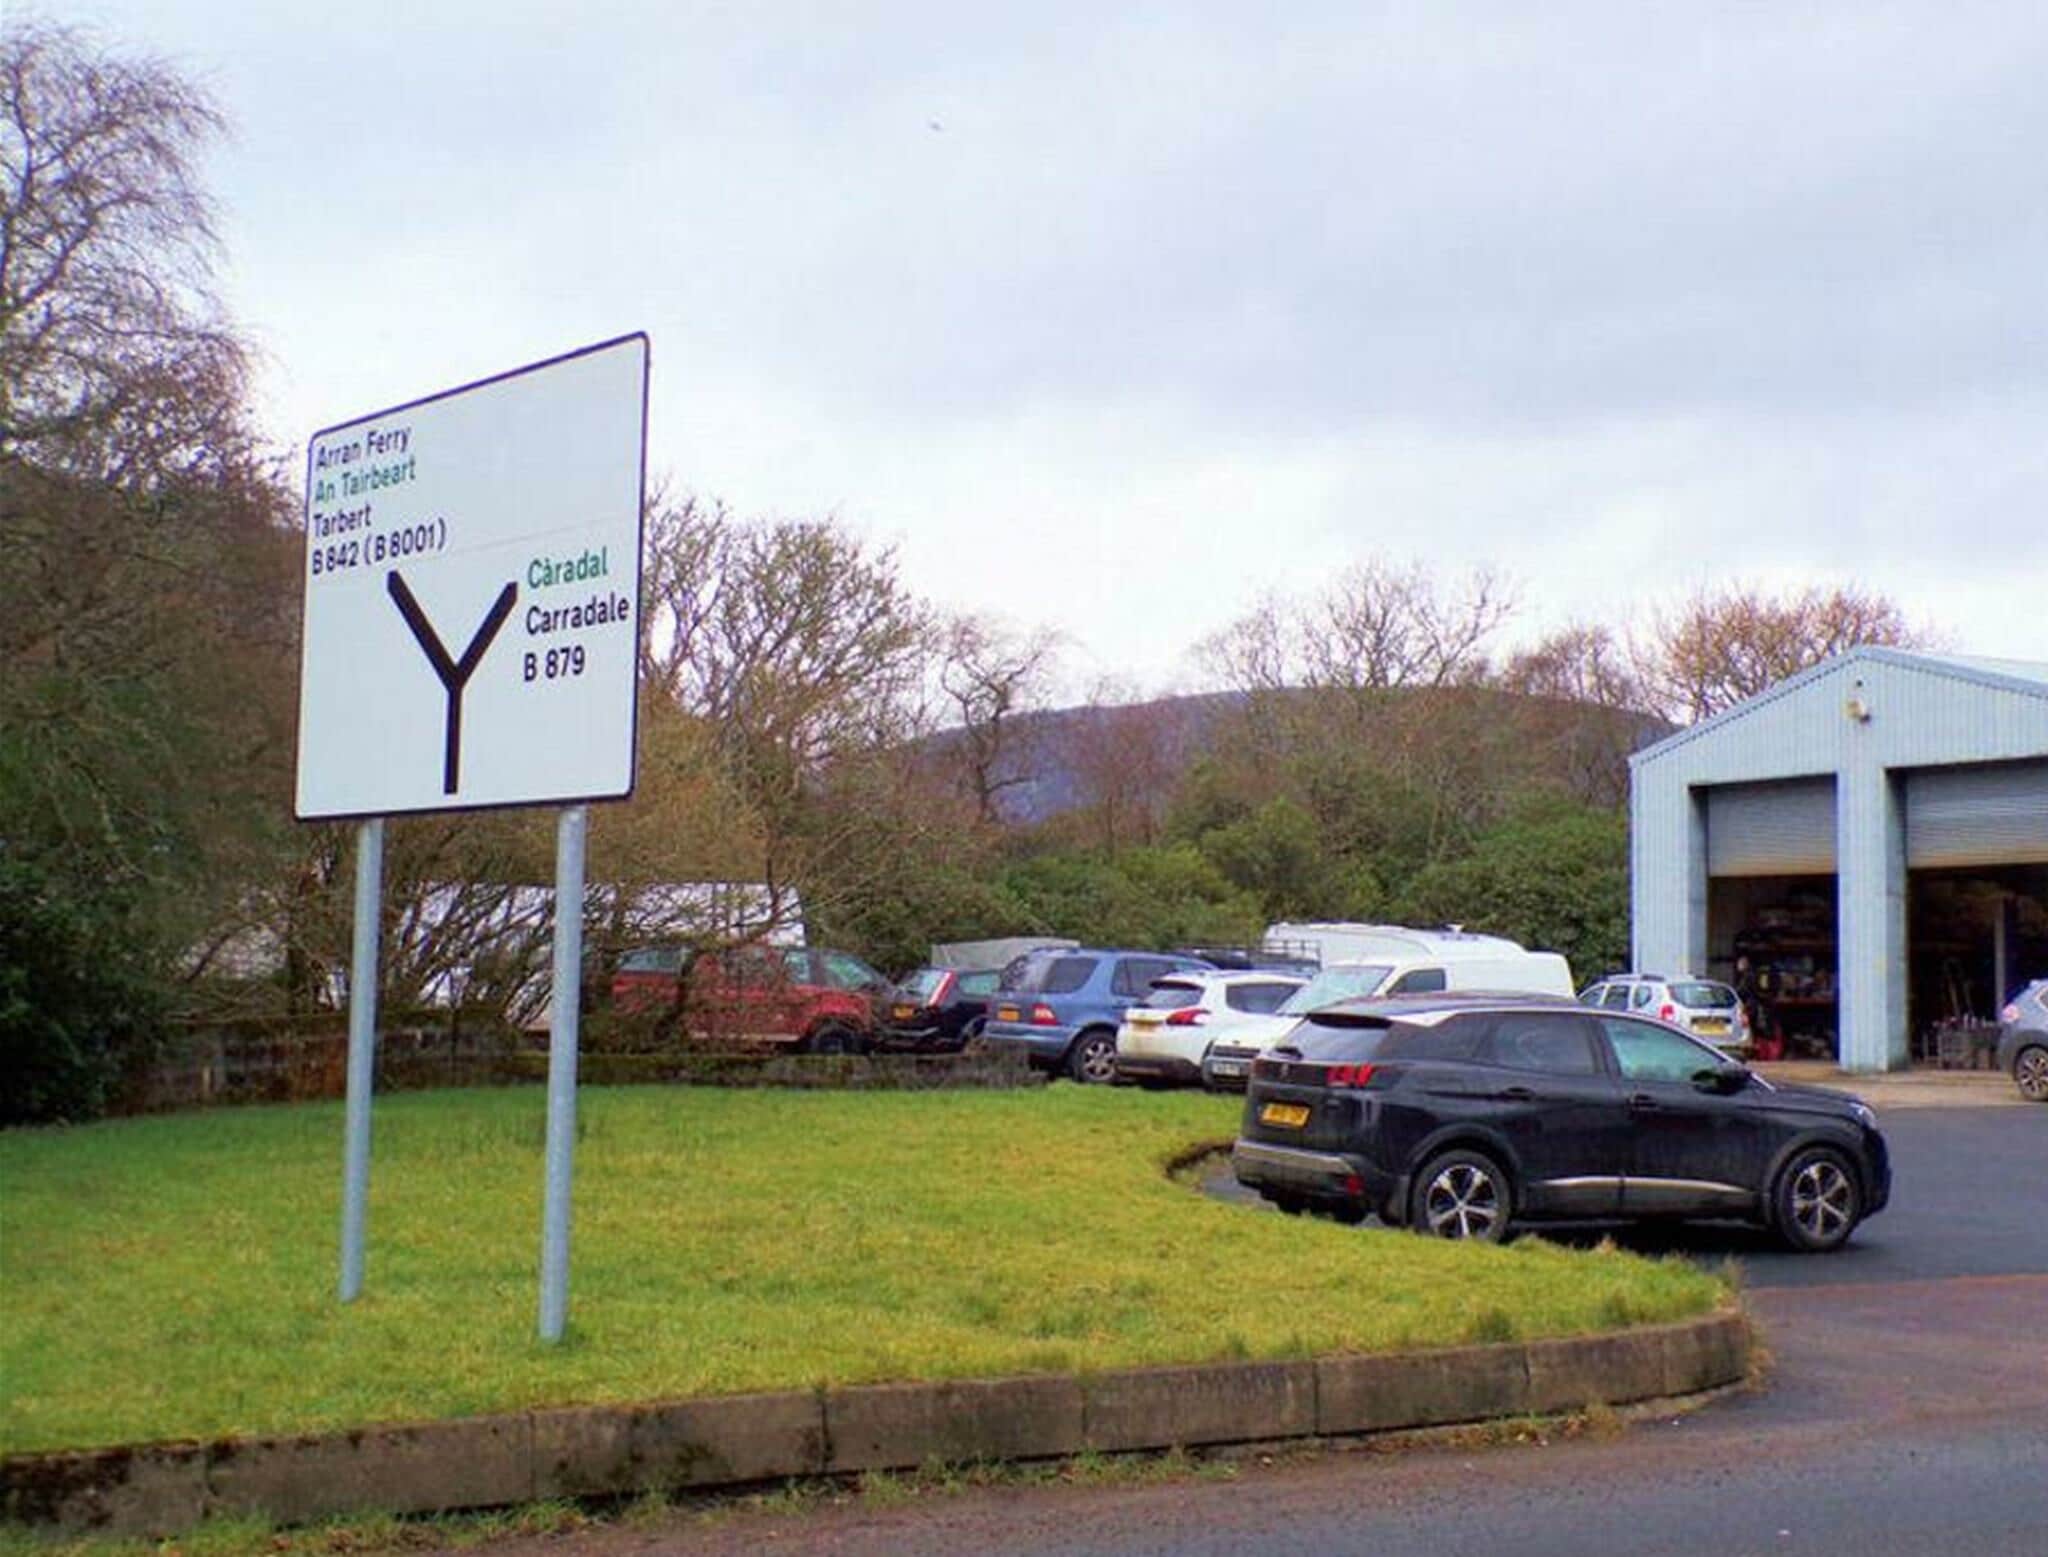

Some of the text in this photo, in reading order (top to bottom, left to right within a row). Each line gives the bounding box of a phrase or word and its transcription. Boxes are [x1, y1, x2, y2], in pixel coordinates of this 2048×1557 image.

[316, 426, 410, 470] Arran Ferry
[314, 458, 415, 503] An Tairbeart
[313, 504, 371, 537] Tarbert
[528, 546, 608, 589] Càradal
[526, 592, 630, 635] Carradale
